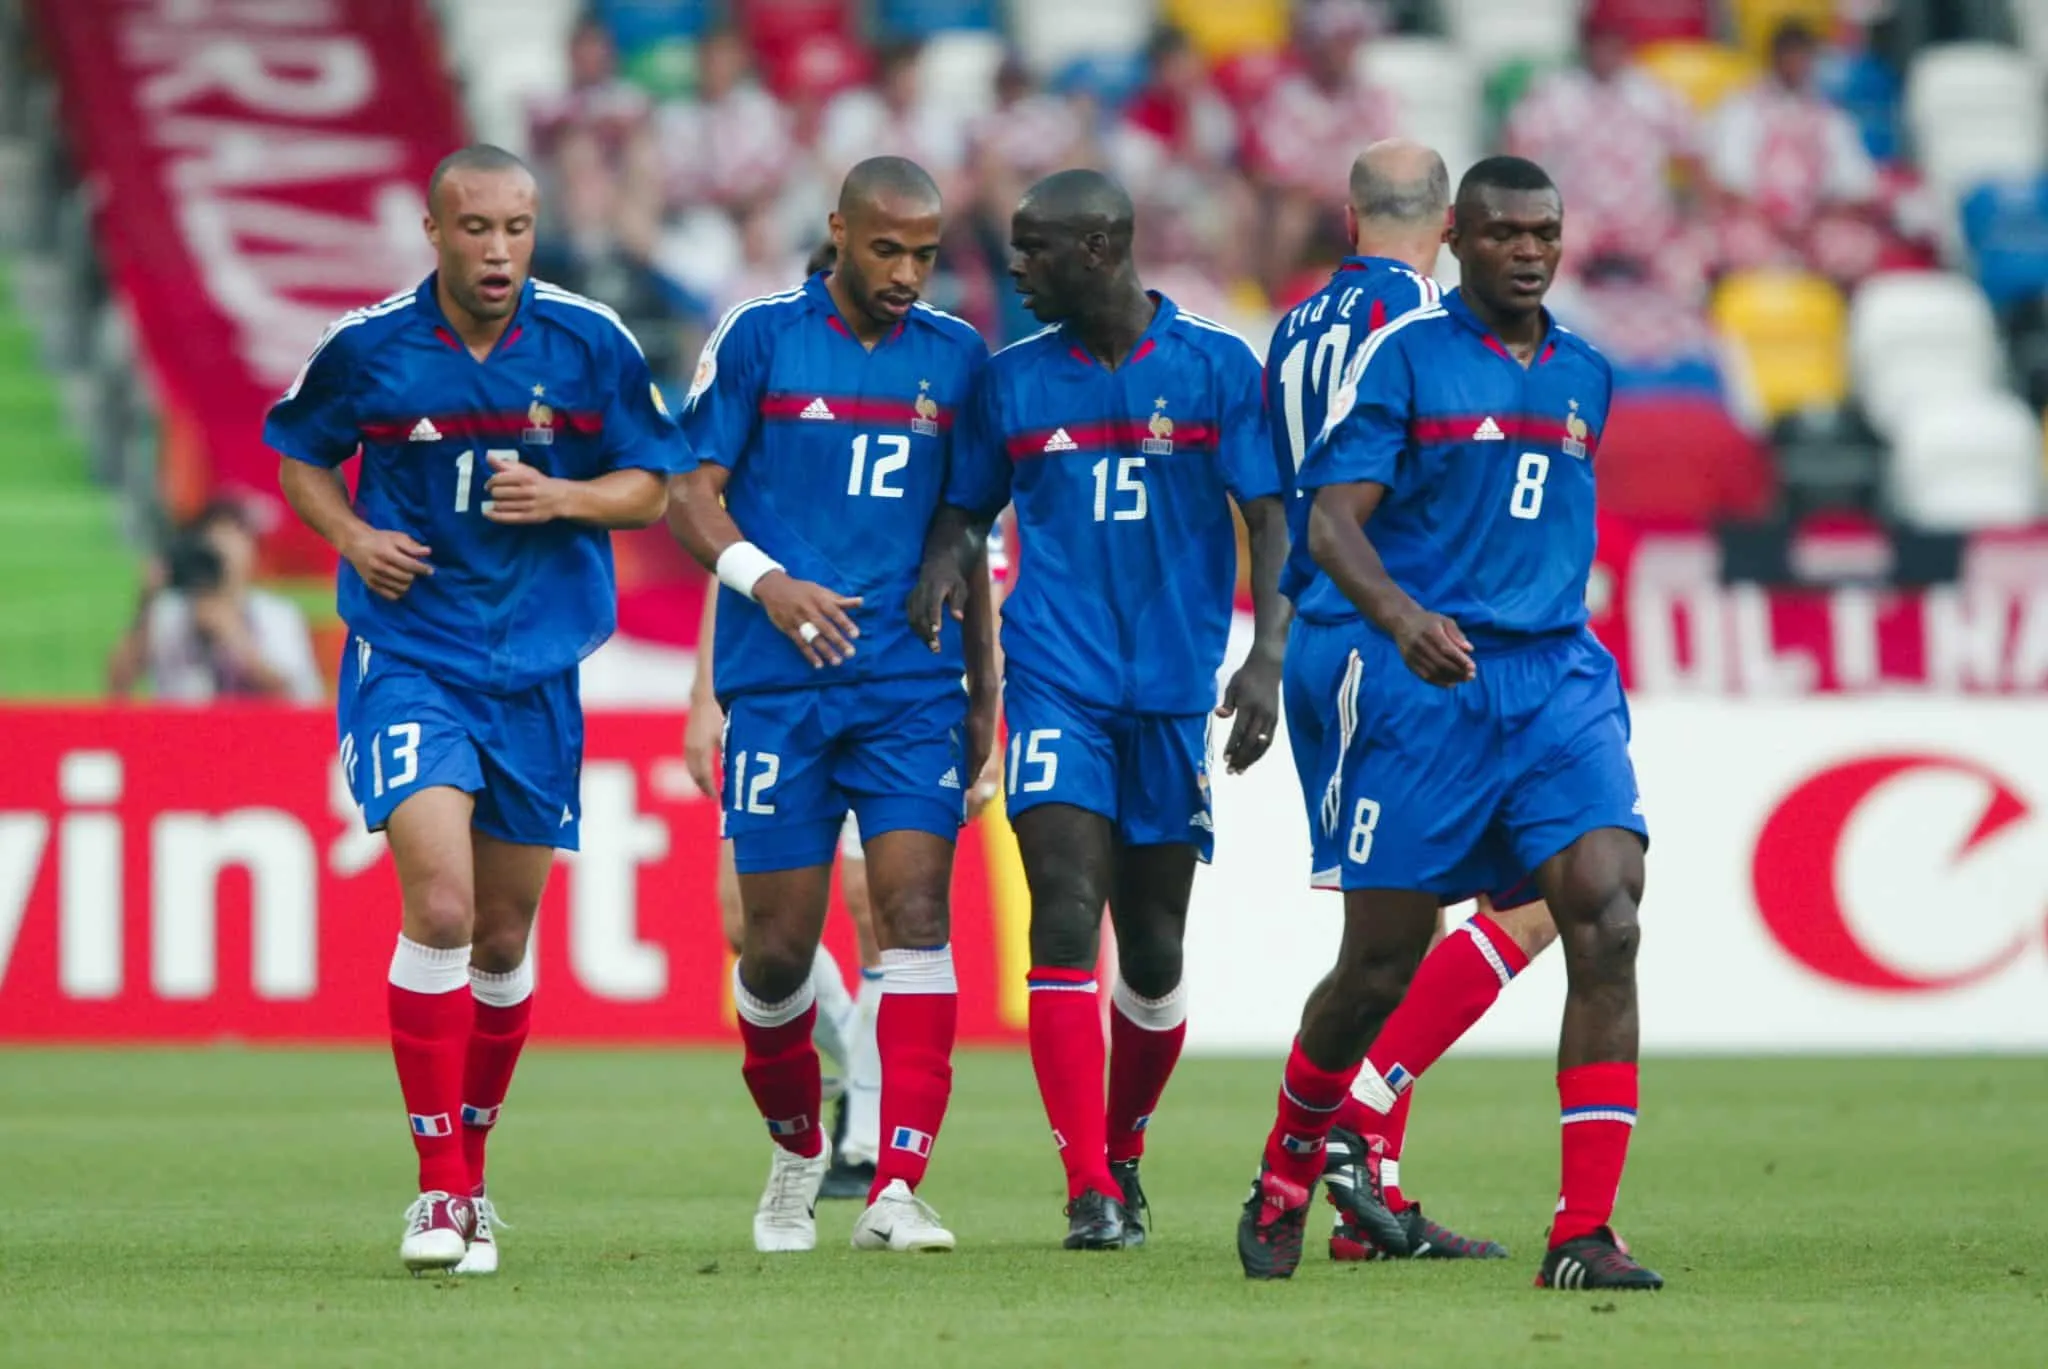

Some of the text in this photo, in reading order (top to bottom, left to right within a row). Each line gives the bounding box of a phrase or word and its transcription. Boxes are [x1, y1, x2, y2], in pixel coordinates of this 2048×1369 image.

[847, 433, 911, 498] 12
[1091, 457, 1148, 522] 15
[1509, 452, 1550, 520] 8
[371, 722, 422, 799] 13
[734, 750, 781, 815] 12
[1008, 728, 1062, 796] 15
[1347, 797, 1381, 864] 8
[1750, 752, 2048, 996] C
